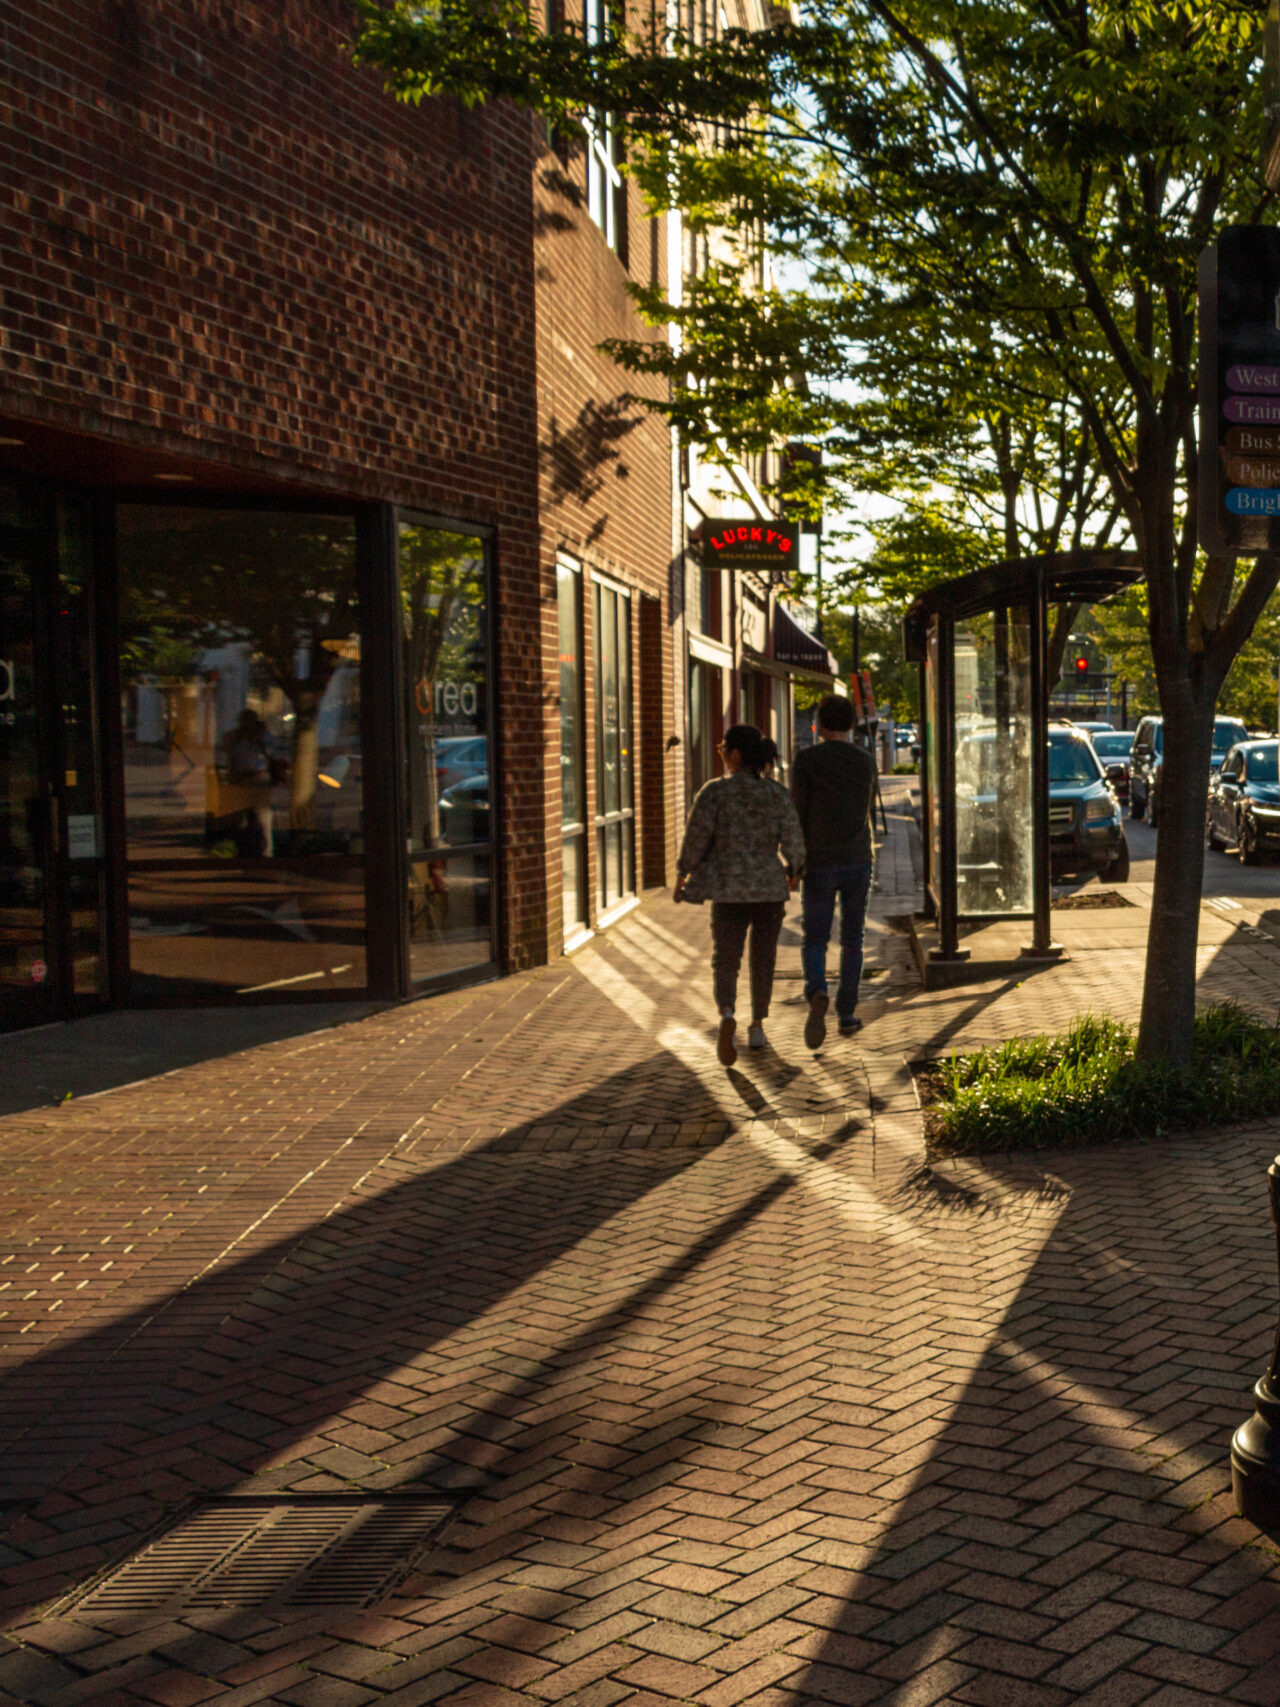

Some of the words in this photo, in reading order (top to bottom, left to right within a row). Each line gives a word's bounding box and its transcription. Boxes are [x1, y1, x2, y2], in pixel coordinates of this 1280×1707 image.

[1235, 367, 1278, 386] West
[1239, 432, 1272, 449] Bus
[710, 526, 792, 553] LUCKY'S
[416, 680, 478, 716] area
